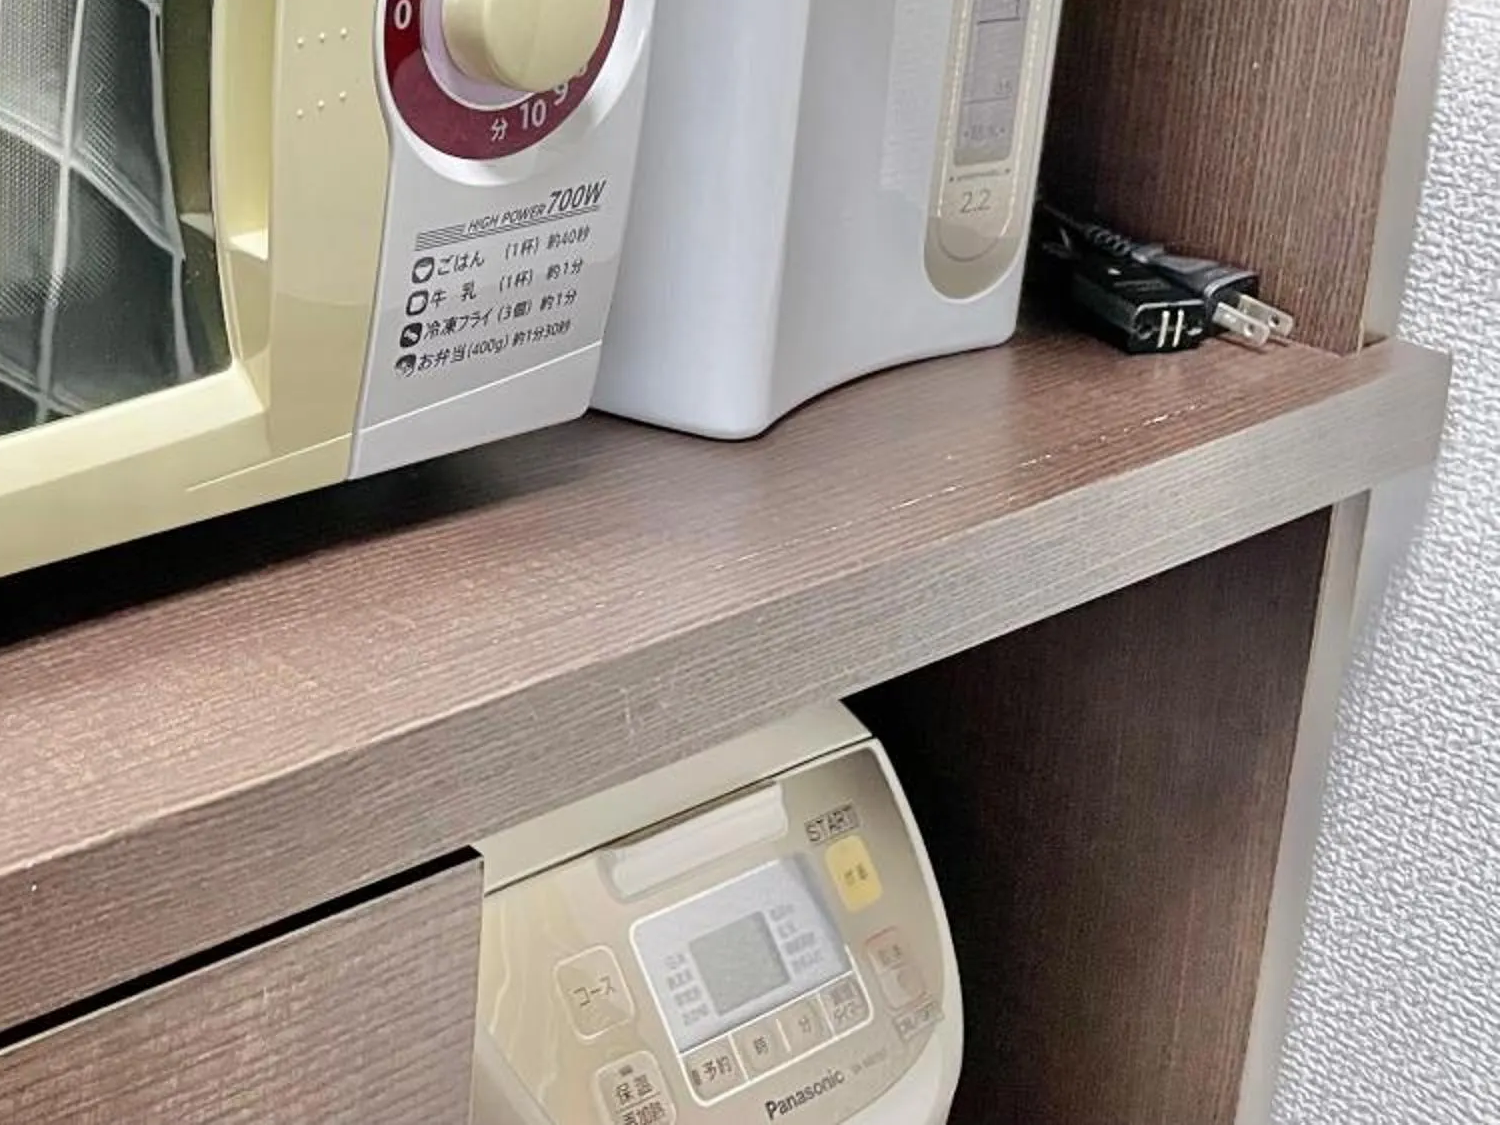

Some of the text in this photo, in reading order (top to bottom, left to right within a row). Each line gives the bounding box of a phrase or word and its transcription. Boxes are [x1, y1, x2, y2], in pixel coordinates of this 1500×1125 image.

[553, 81, 569, 106] 9
[491, 116, 509, 142] 分
[519, 98, 547, 130] 10
[467, 180, 607, 234] HIGH POWER 700W
[437, 250, 485, 276] ごはん
[423, 307, 494, 340] 冷凍フライ
[805, 805, 858, 844] START
[573, 976, 615, 1007] コース
[764, 1069, 846, 1120] Panasonic
